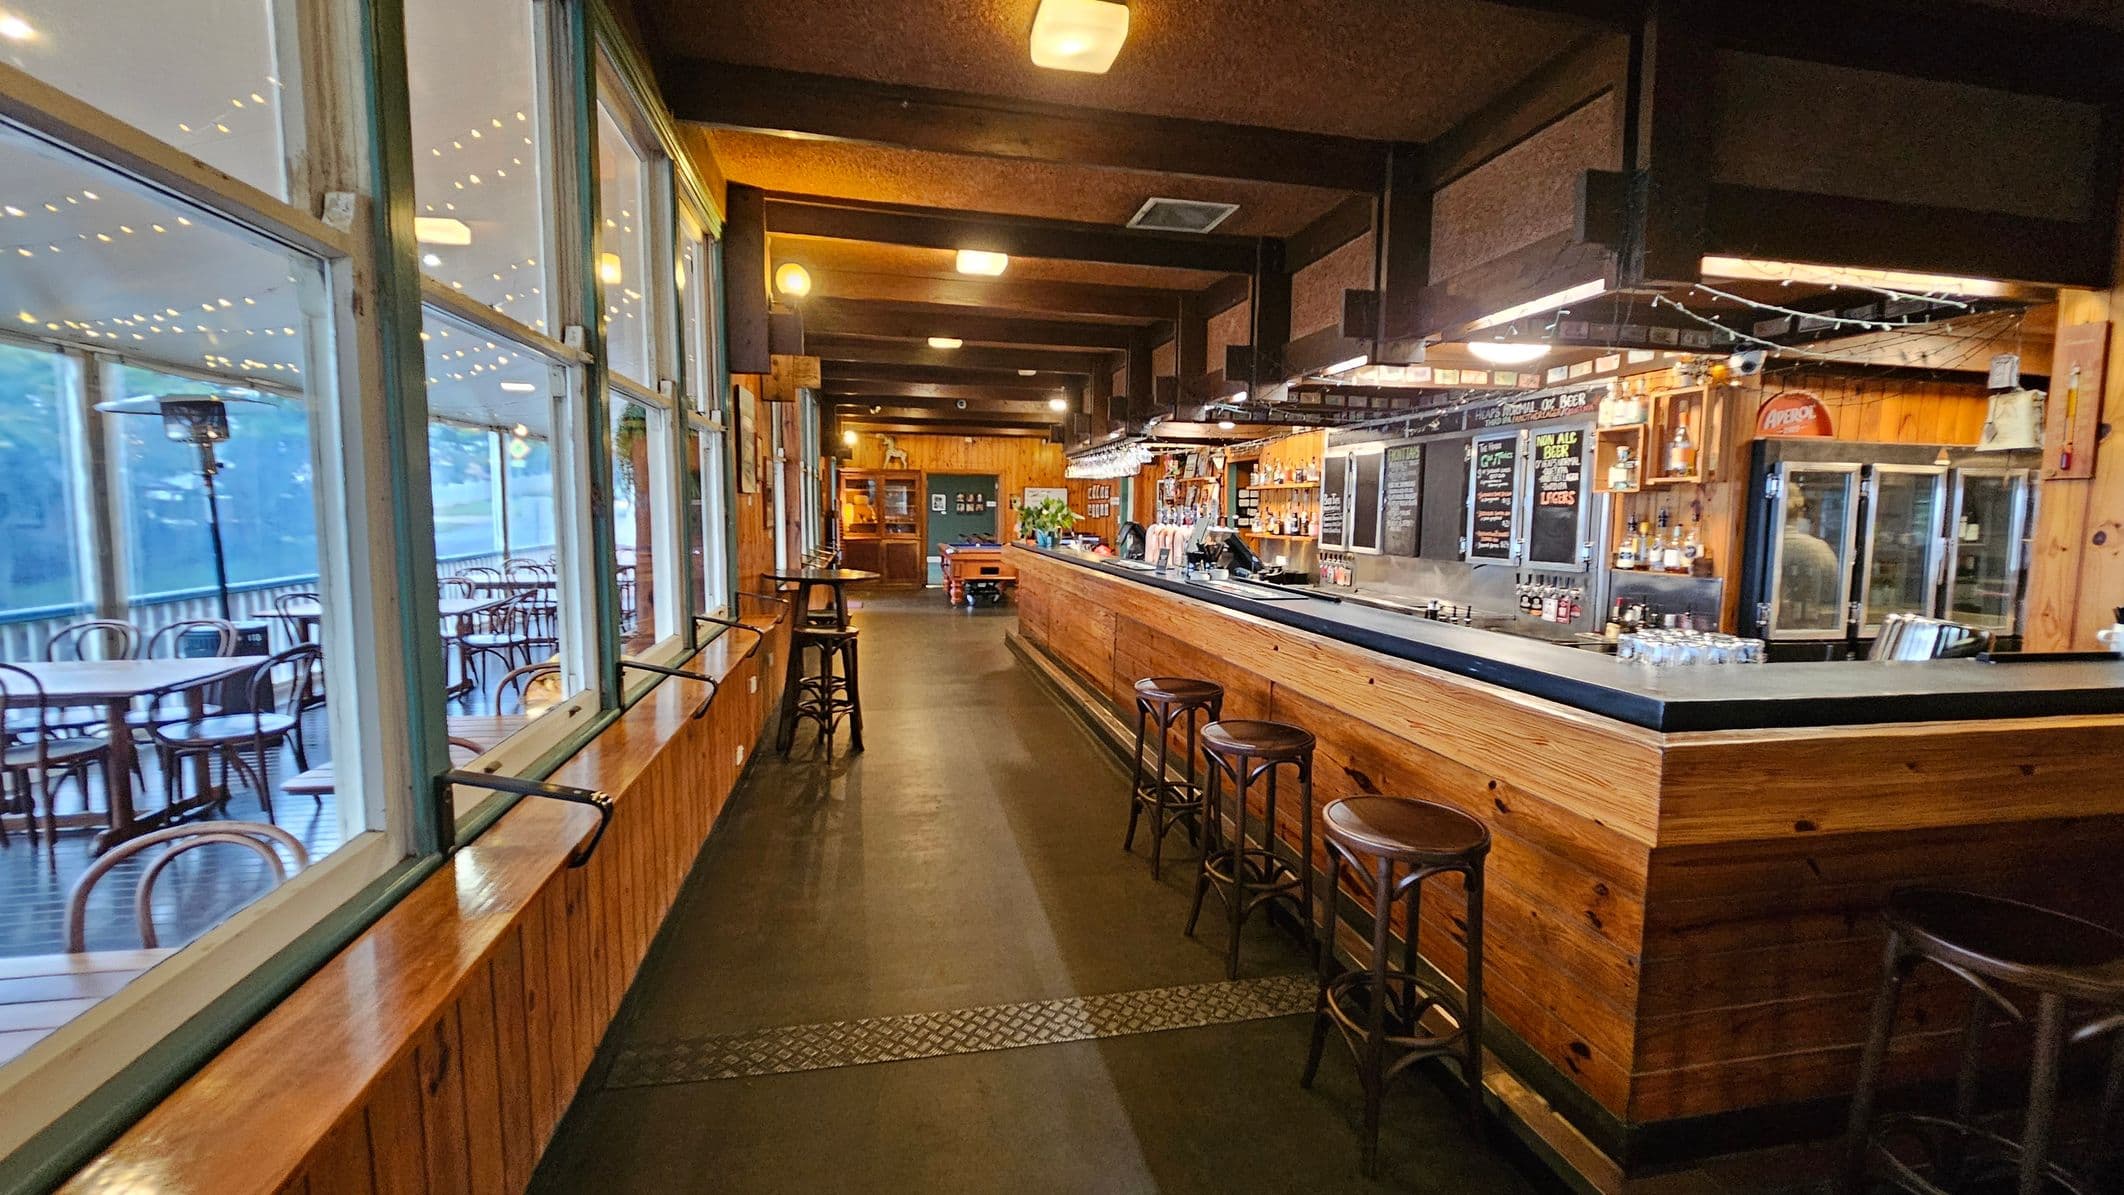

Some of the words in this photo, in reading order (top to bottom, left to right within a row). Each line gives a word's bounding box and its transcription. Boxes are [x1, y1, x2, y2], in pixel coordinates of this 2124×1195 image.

[1560, 394, 1586, 409] BEER
[1763, 406, 1816, 430] APEROL
[1536, 434, 1555, 447] NON
[1556, 432, 1577, 444] ALC
[1543, 445, 1569, 459] BEER
